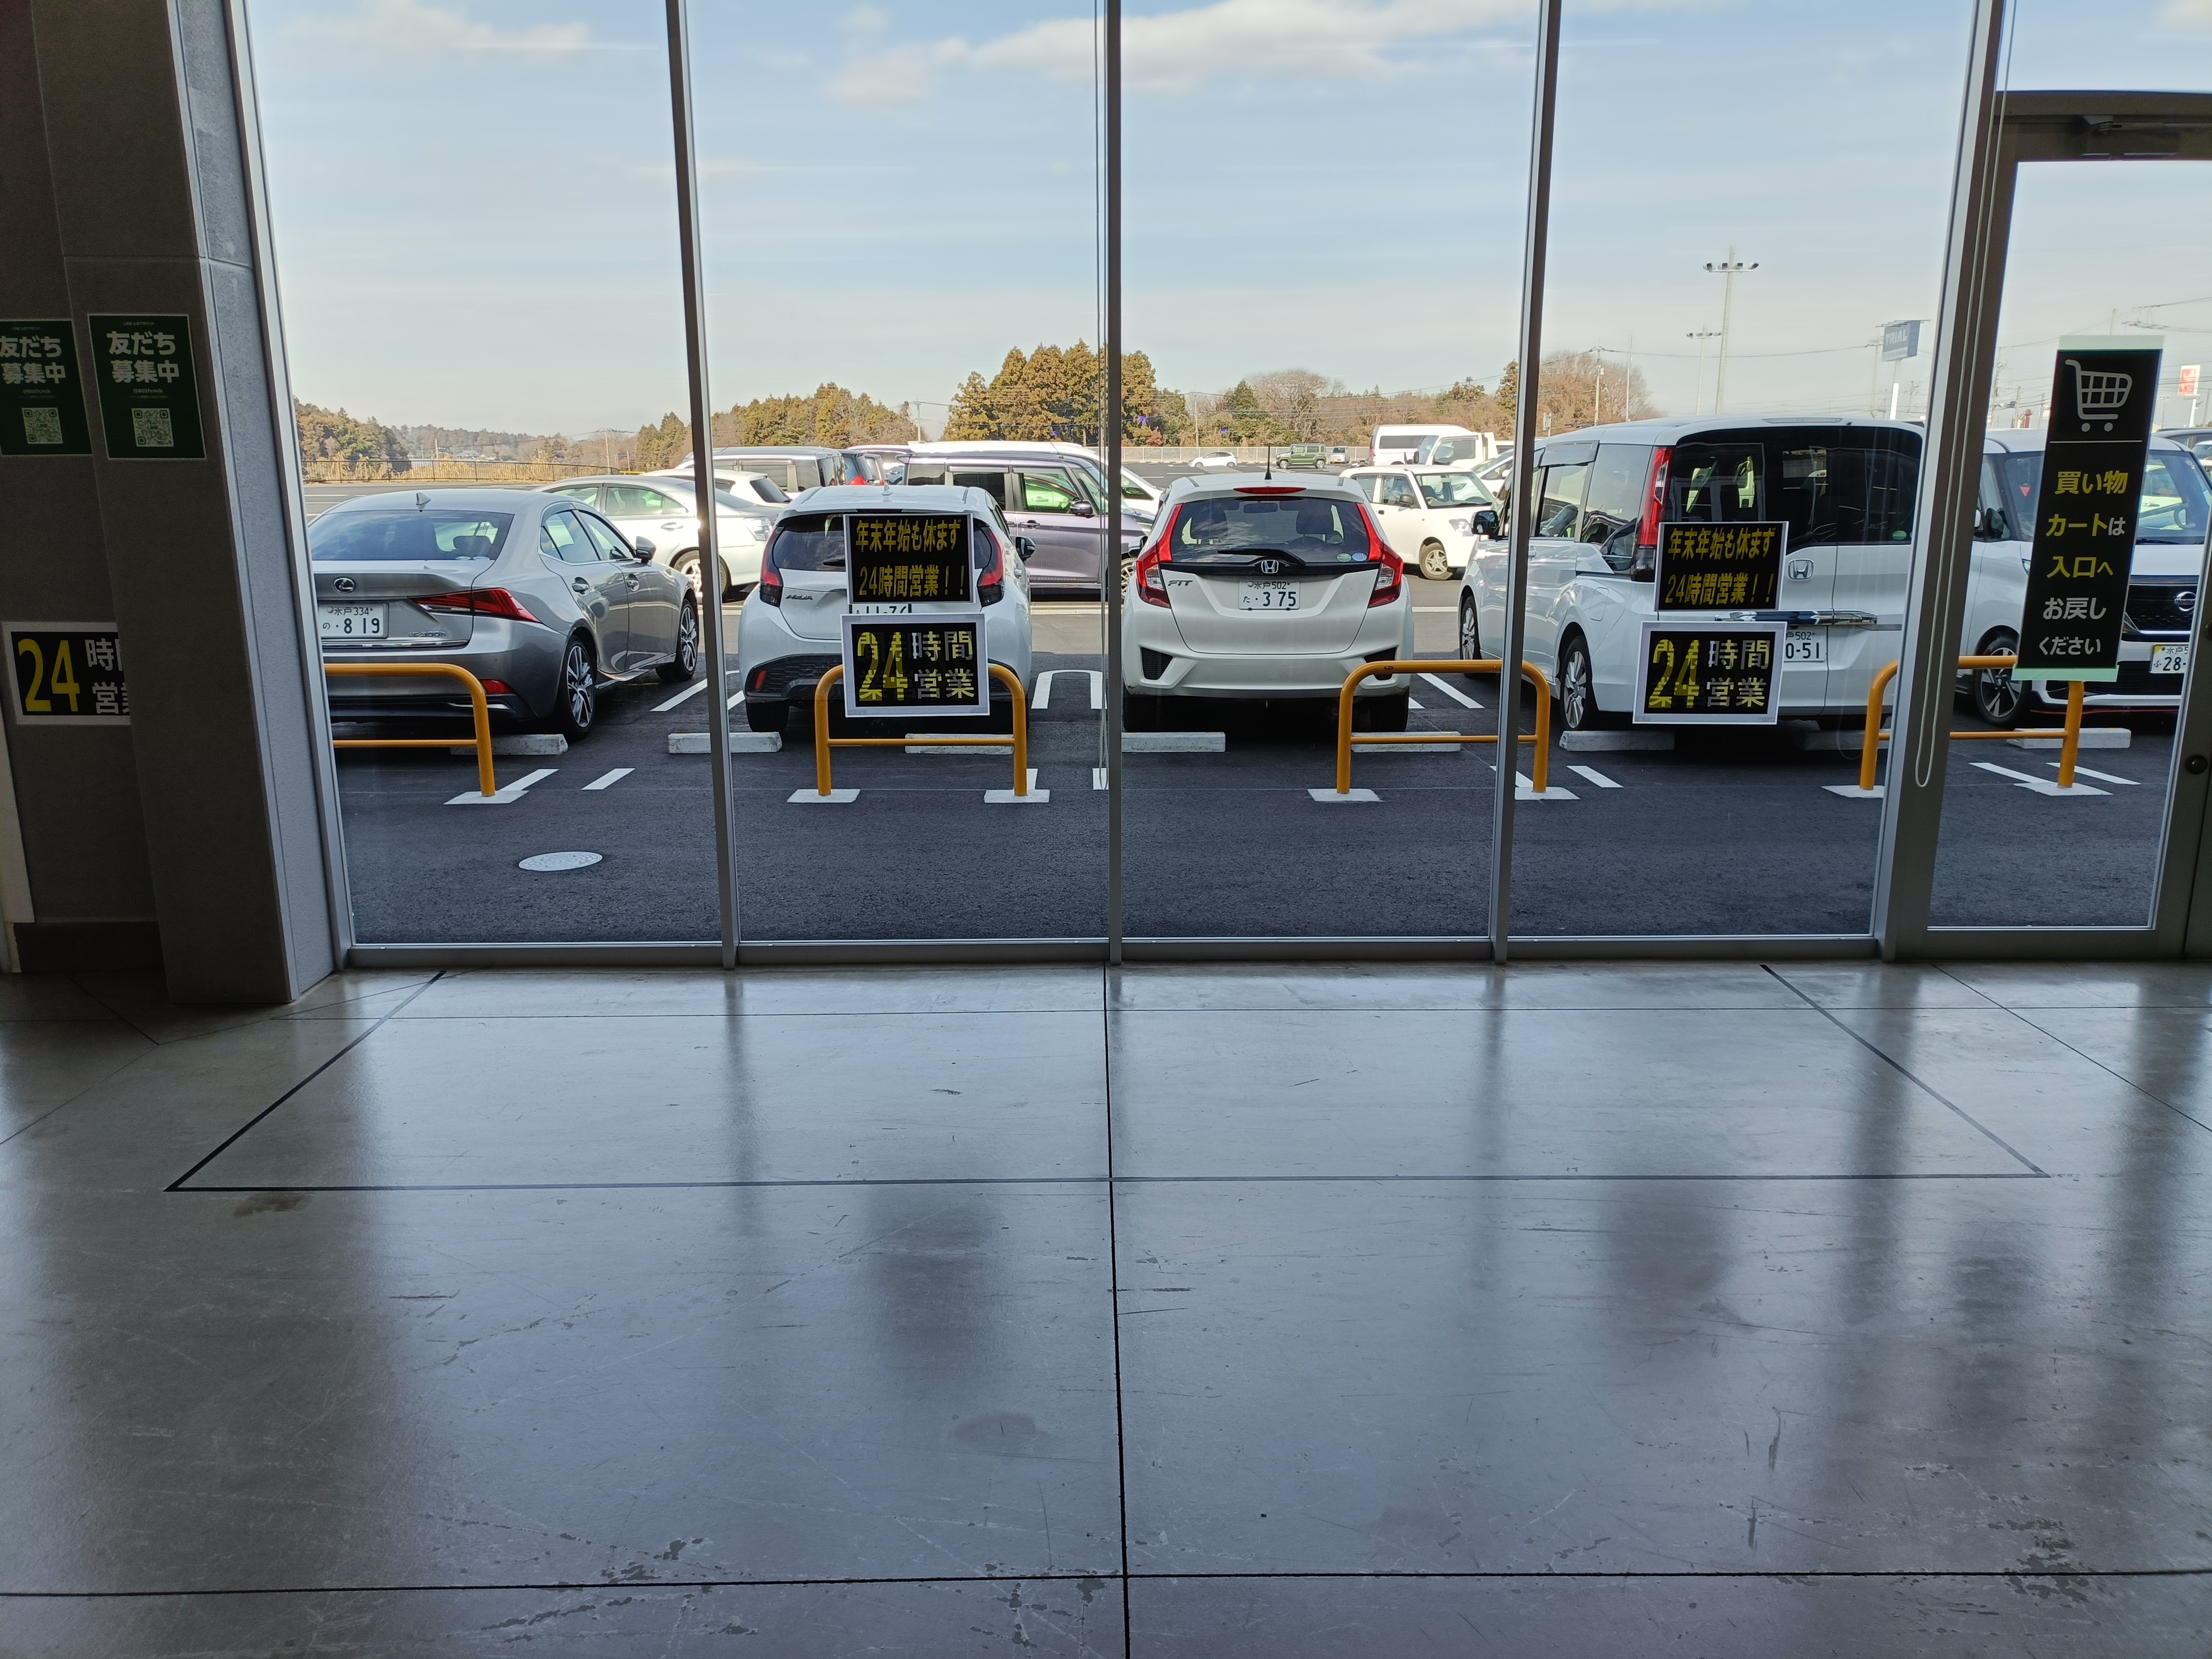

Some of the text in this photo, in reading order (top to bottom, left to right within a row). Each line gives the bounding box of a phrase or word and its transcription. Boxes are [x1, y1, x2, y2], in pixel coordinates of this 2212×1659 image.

[0, 335, 62, 358] 友だち
[107, 331, 176, 355] 友だち
[1885, 329, 1907, 345] TRIAL
[1, 362, 66, 384] 募集中
[111, 360, 179, 383] 募集中
[2055, 470, 2128, 494] 買い物
[856, 519, 961, 552] 年末年始も休まず
[2046, 513, 2125, 537] カートは
[1668, 527, 1776, 560] 年末年始も休まず
[2046, 556, 2113, 578] 入口へ
[2043, 597, 2107, 619] お戻し
[911, 630, 973, 661] 時間
[1708, 639, 1770, 670] 時間
[2039, 636, 2101, 655] ください
[18, 638, 80, 712] 24
[857, 631, 908, 702] 24
[1648, 639, 1700, 708] 24
[914, 668, 974, 699] 営業
[1706, 677, 1766, 708] 営業
